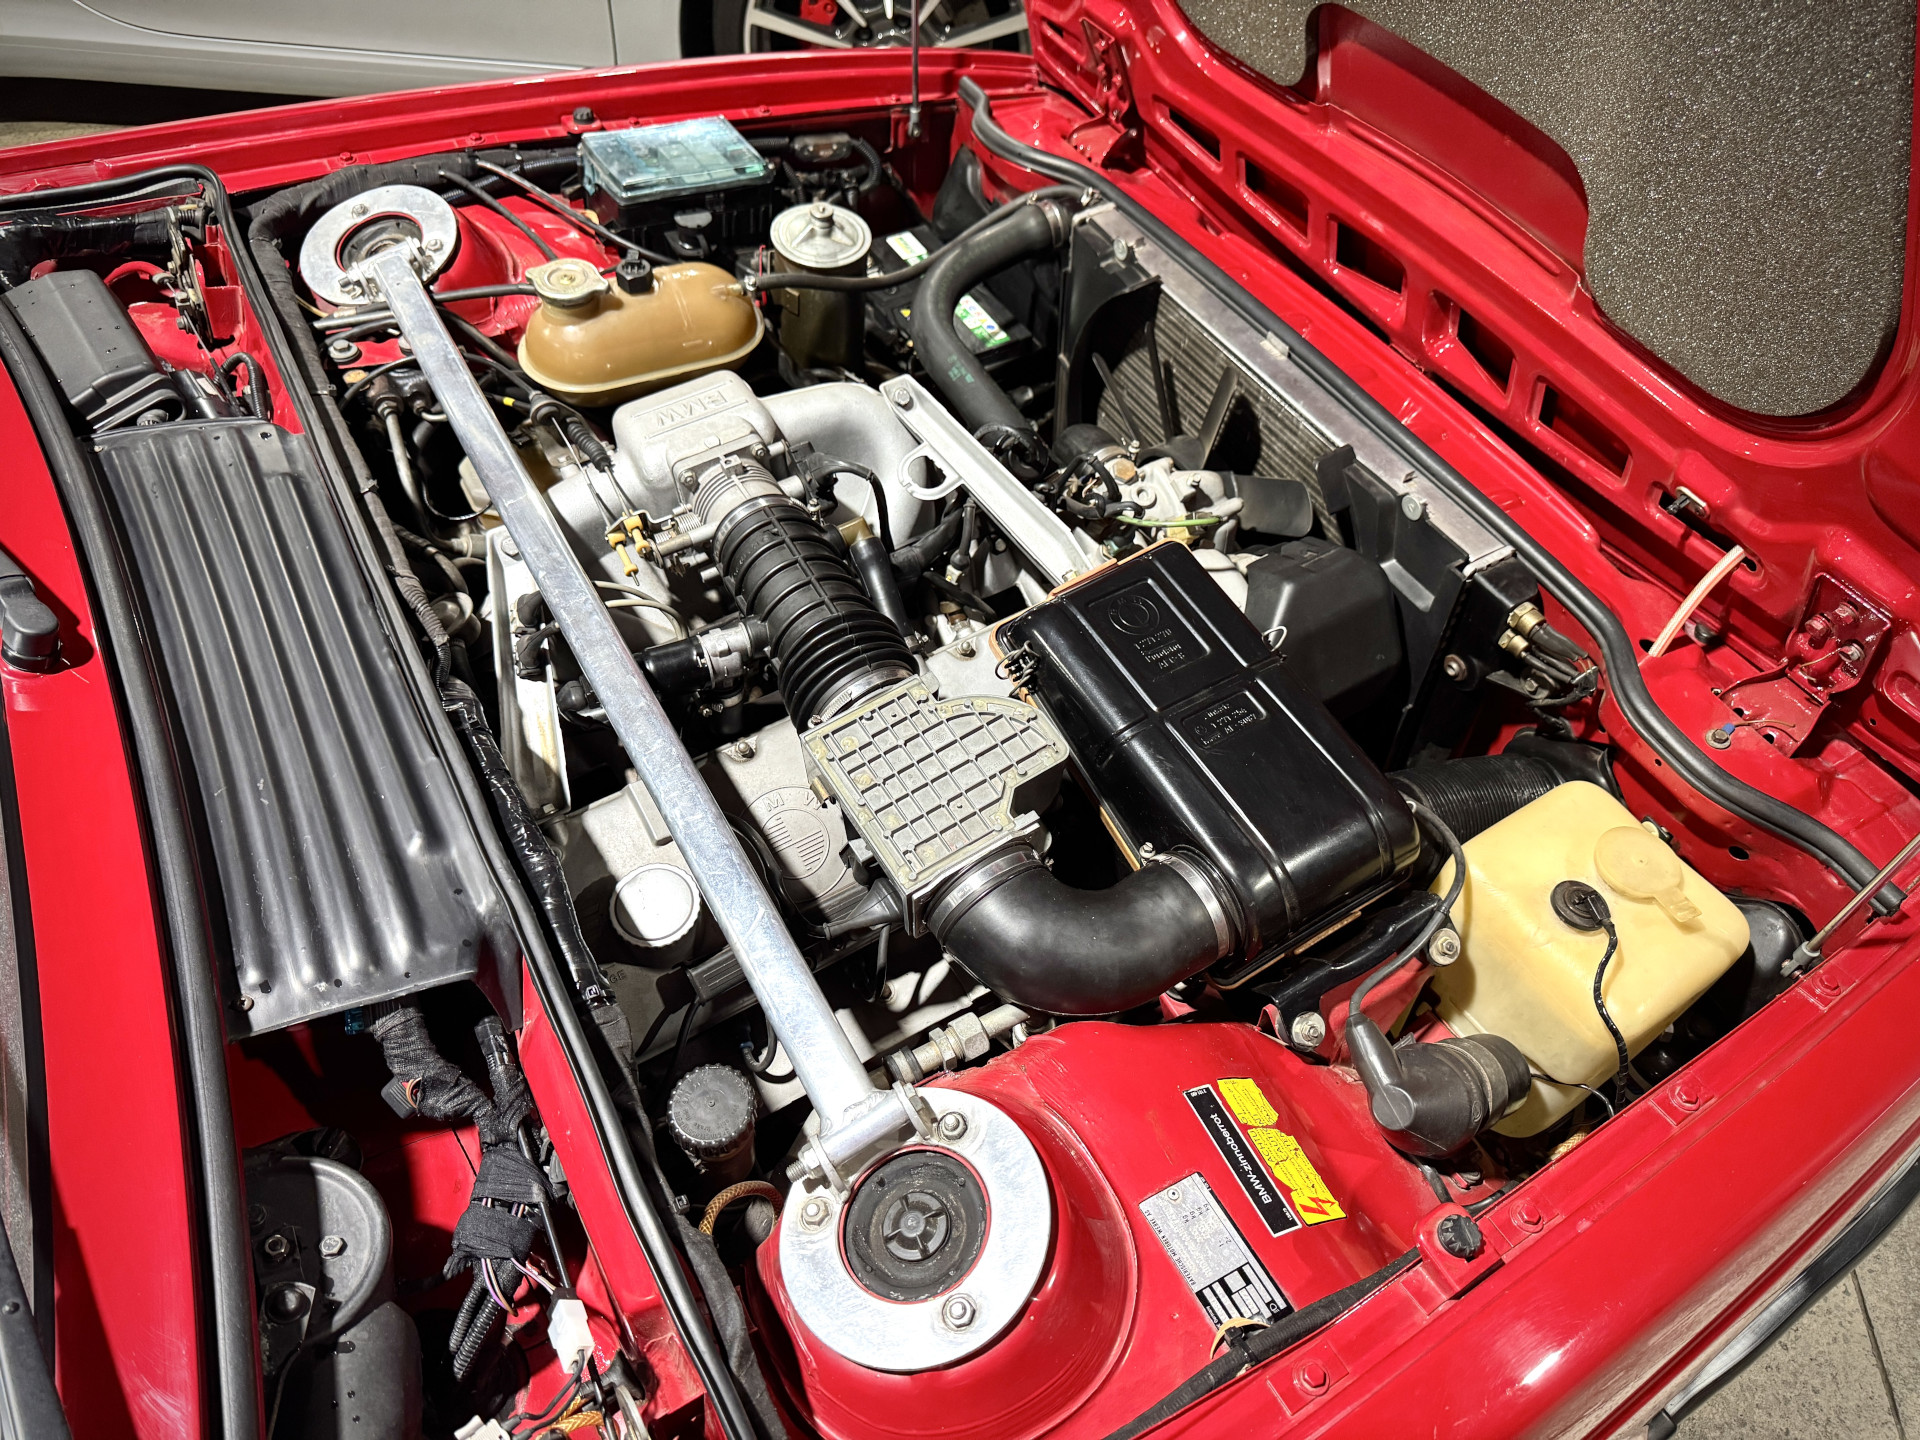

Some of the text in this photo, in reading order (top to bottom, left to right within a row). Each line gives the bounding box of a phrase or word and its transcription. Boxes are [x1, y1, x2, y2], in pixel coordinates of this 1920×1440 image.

[656, 390, 728, 426] BMW
[1210, 1112, 1273, 1205] BMW-zinnoberrot
[1149, 1216, 1163, 1234] WERKE
[1160, 1234, 1178, 1257] MOTOREN
